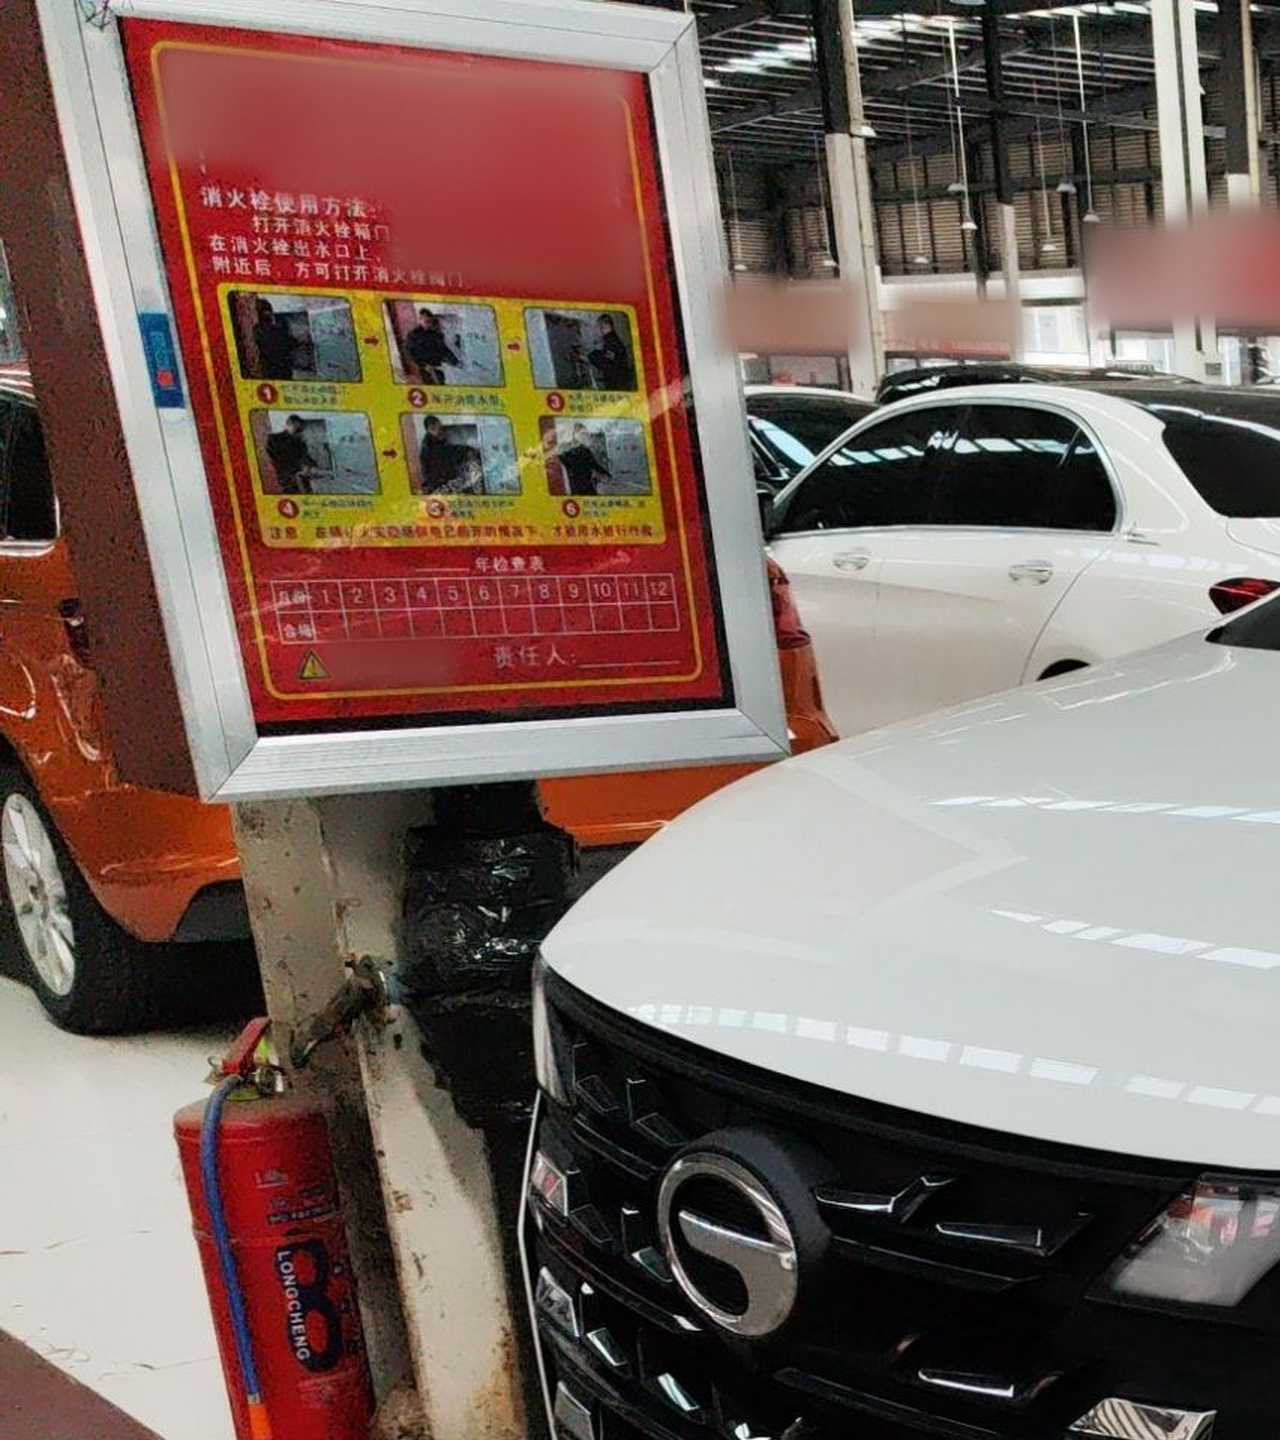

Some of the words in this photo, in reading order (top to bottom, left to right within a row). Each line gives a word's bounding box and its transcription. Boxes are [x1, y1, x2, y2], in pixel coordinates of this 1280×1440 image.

[321, 588, 329, 604] 1
[352, 587, 363, 604] 2
[384, 586, 395, 603] 3
[416, 586, 427, 602] 4
[448, 585, 458, 601] 5
[479, 585, 489, 600] 6
[509, 584, 519, 598] 7
[540, 584, 550, 599] 8
[569, 583, 579, 598] 9
[594, 582, 611, 597] 10
[624, 582, 639, 596] 11
[651, 581, 667, 596] 12
[277, 1250, 311, 1361] LONGCHENG
